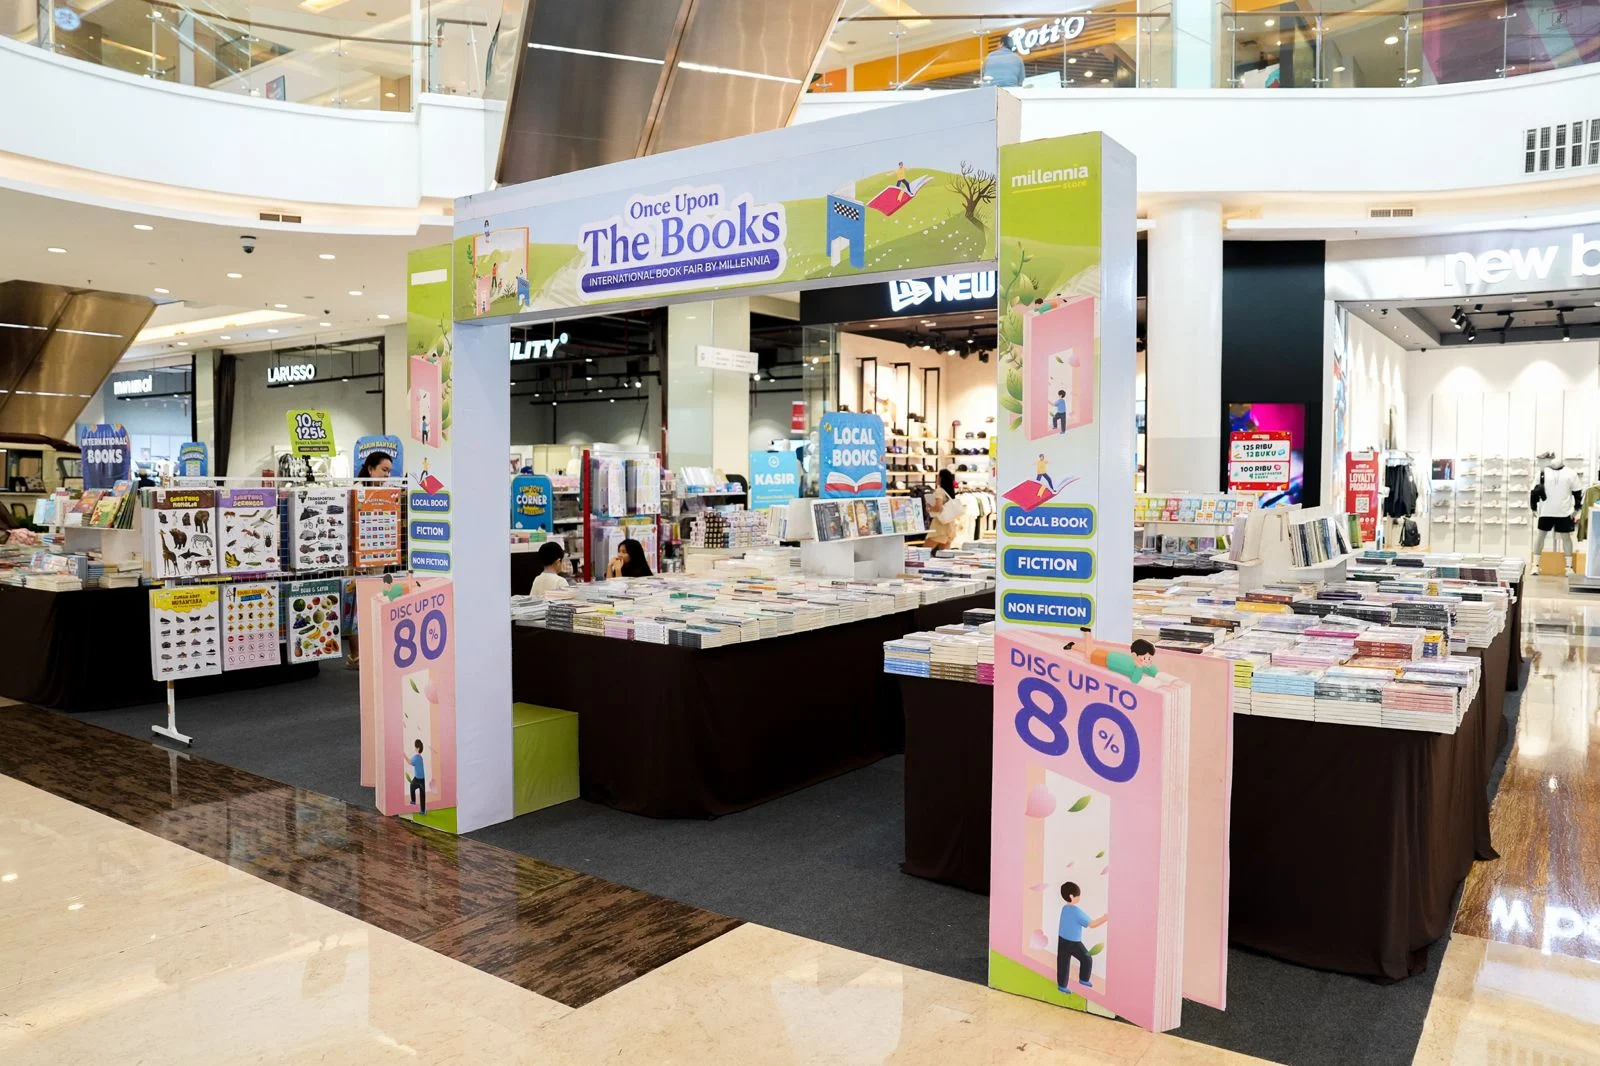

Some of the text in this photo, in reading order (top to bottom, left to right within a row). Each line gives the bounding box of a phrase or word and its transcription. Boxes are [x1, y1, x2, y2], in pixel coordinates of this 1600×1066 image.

[1007, 16, 1085, 55] Roti'O
[1011, 164, 1089, 188] millennia
[1062, 180, 1087, 189] store
[630, 192, 719, 219] Once Upon
[583, 201, 780, 267] The Books
[589, 255, 771, 287] INTERNATIONAL BOOK FAIR BY MILLENNIA
[1444, 245, 1559, 286] new
[934, 270, 996, 302] NEW
[267, 363, 316, 383] LARUSSO
[296, 413, 312, 427] 10
[296, 427, 326, 439] 125k
[833, 427, 875, 445] LOCAL
[81, 437, 128, 446] INTERNATIONAL
[87, 448, 123, 464] BOOKS
[832, 449, 878, 467] BOOKS
[754, 473, 795, 485] KASIR
[1349, 473, 1375, 483] LOYALTY
[1349, 482, 1376, 491] PROGRAM
[412, 499, 448, 507] LOCAL BOOK
[516, 494, 547, 505] CORNER
[1009, 515, 1088, 528] LOCAL BOOK
[416, 526, 444, 536] FICTION
[412, 557, 448, 566] NON FICTION
[1017, 556, 1077, 572] FICTION
[390, 593, 445, 621] DISC UP TO
[1007, 602, 1087, 618] NON FICTION
[1010, 647, 1138, 711] DISC UP TO
